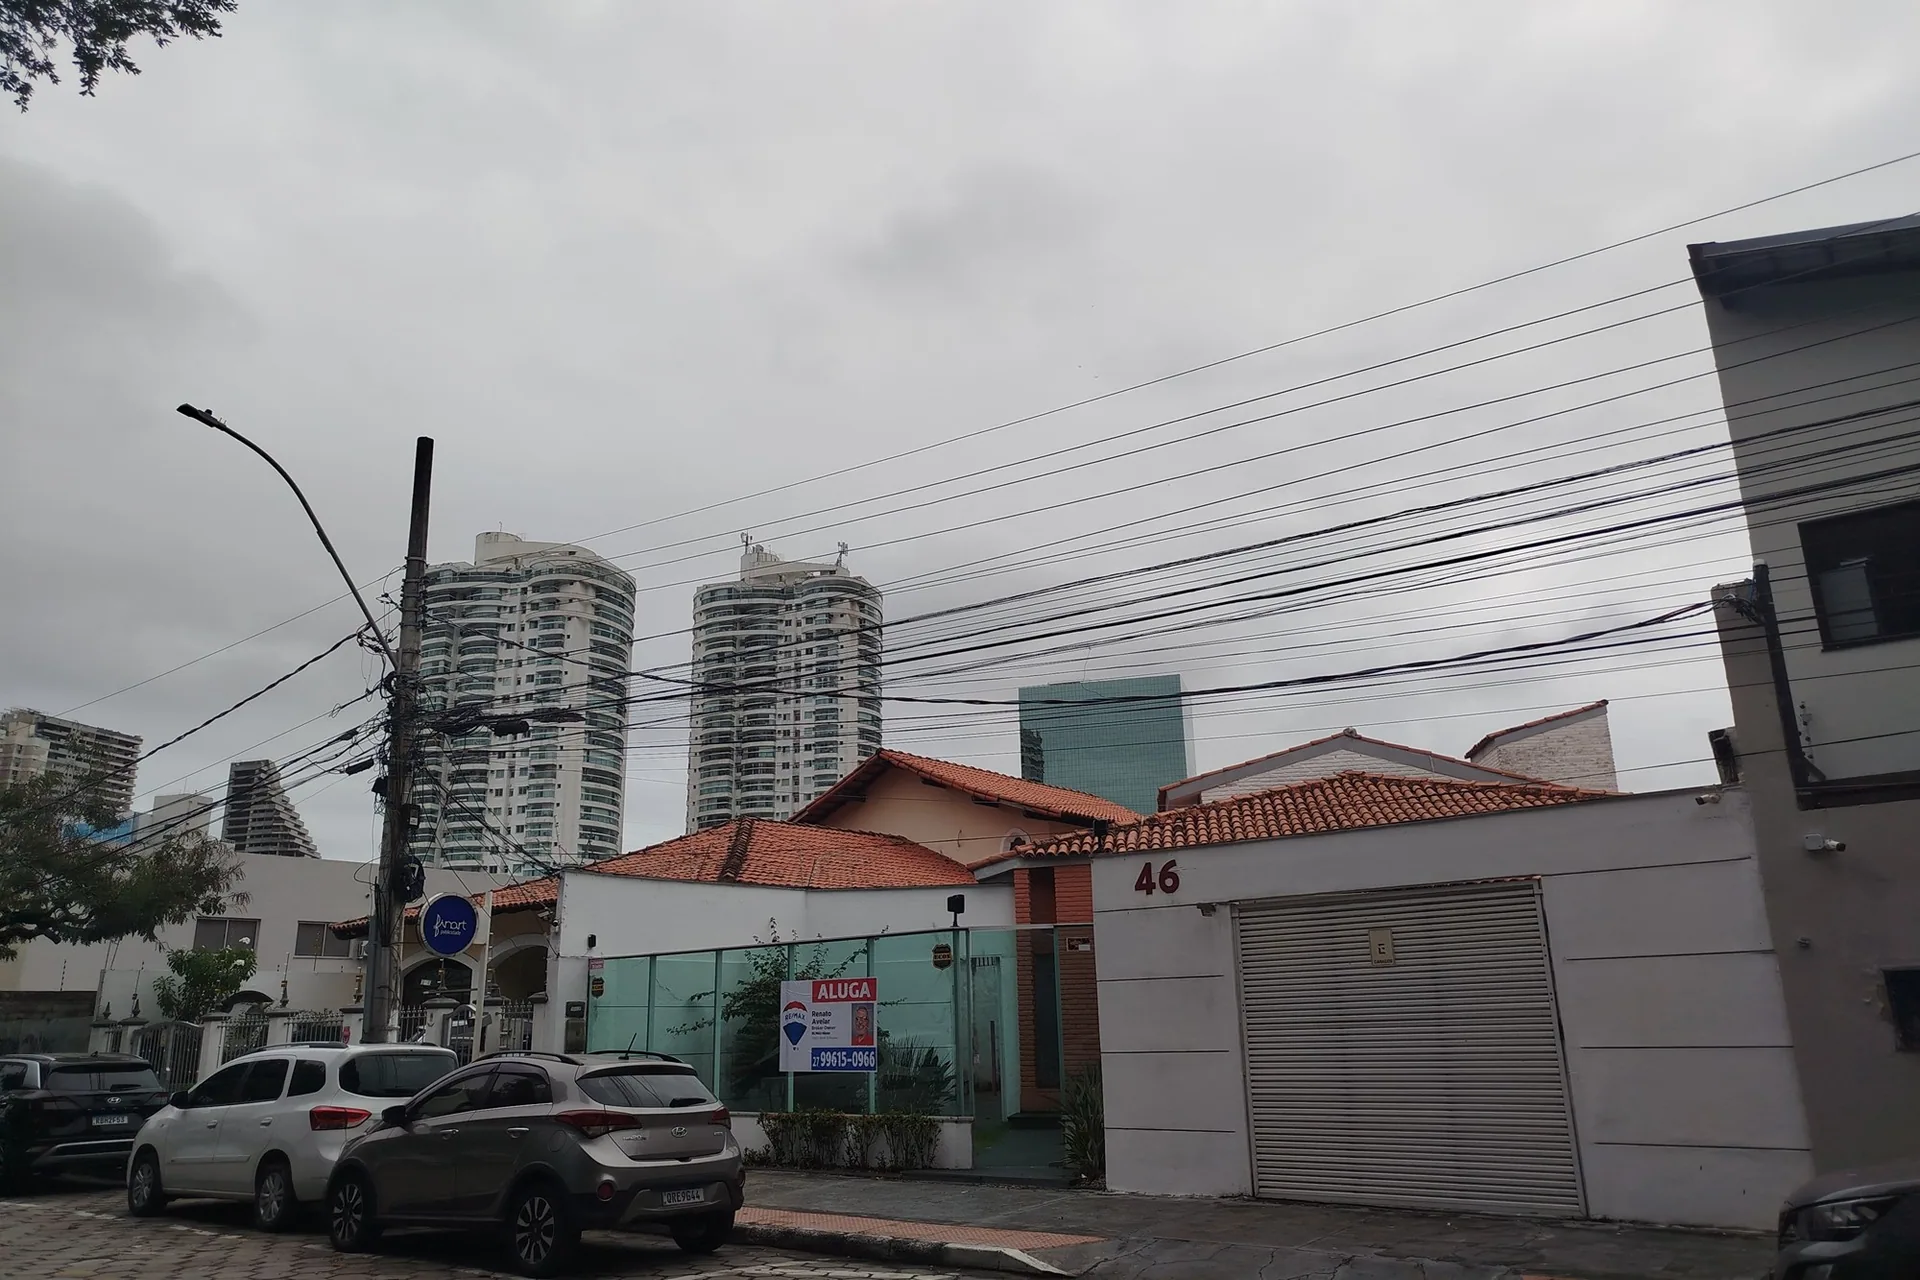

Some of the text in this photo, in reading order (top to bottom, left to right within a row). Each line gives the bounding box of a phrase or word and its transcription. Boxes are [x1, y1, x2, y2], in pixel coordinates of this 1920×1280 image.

[1135, 859, 1179, 895] 46
[817, 982, 871, 999] ALUGA
[785, 1012, 806, 1021] RE/MAX
[811, 1010, 832, 1018] Renato
[812, 1051, 875, 1068] 27 99615-0966
